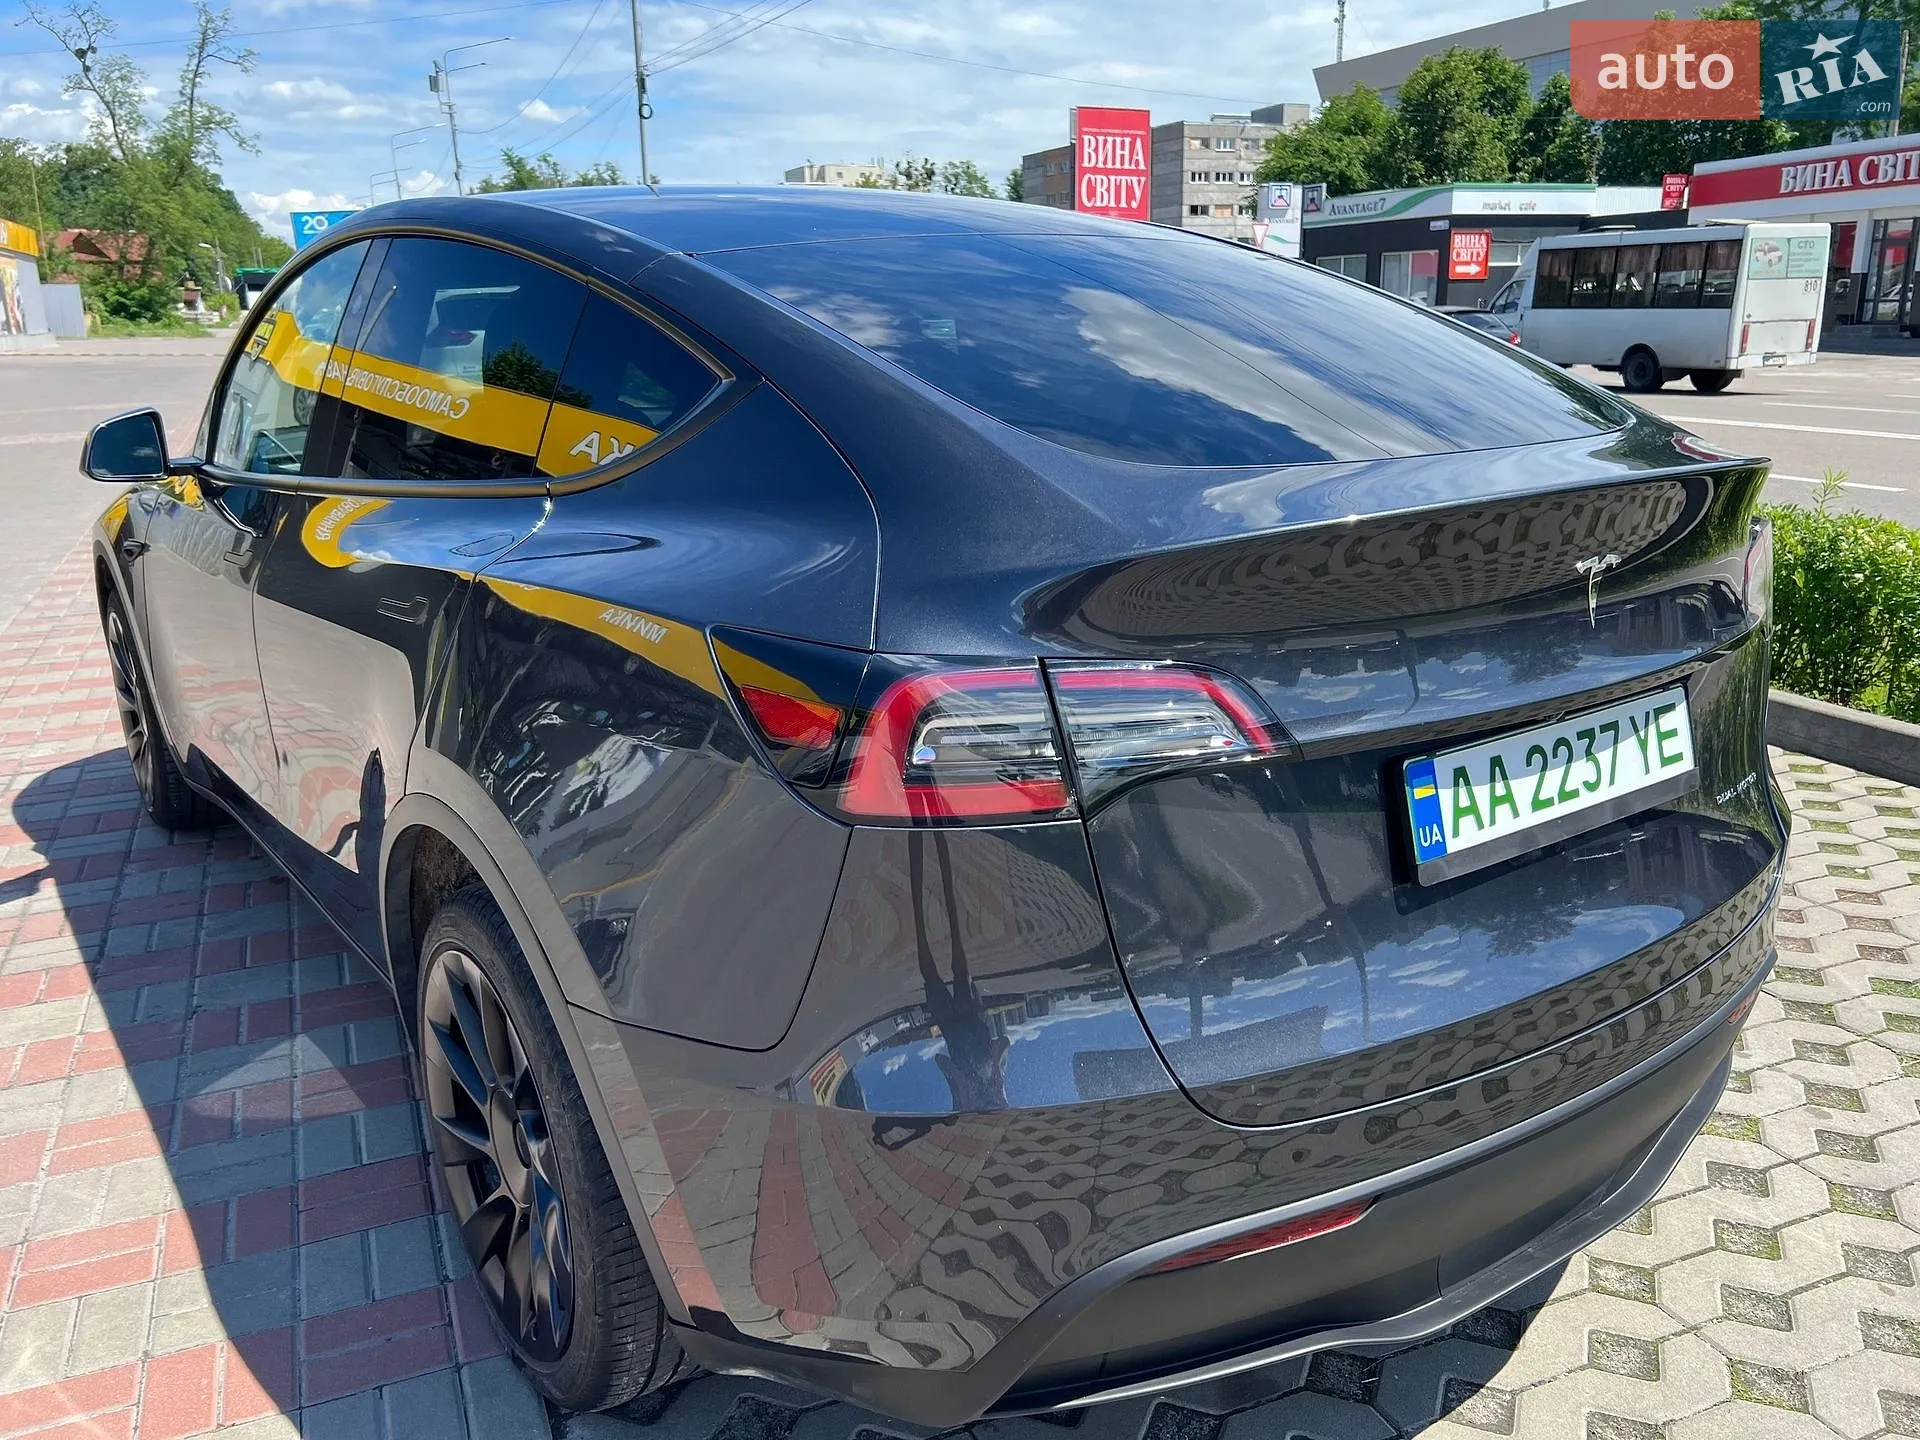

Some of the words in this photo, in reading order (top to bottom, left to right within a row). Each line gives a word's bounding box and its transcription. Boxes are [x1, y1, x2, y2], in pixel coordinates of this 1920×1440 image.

[1081, 134, 1147, 170] ВИНА
[1081, 173, 1147, 208] СВІТУ
[1779, 160, 1853, 193] ВИНА
[1452, 248, 1487, 262] СВІТУ
[1454, 234, 1487, 247] ВИНА
[1453, 755, 1519, 838] AA
[1526, 720, 1620, 813] 2237
[1629, 703, 1684, 775] YE
[1418, 823, 1443, 848] UA
